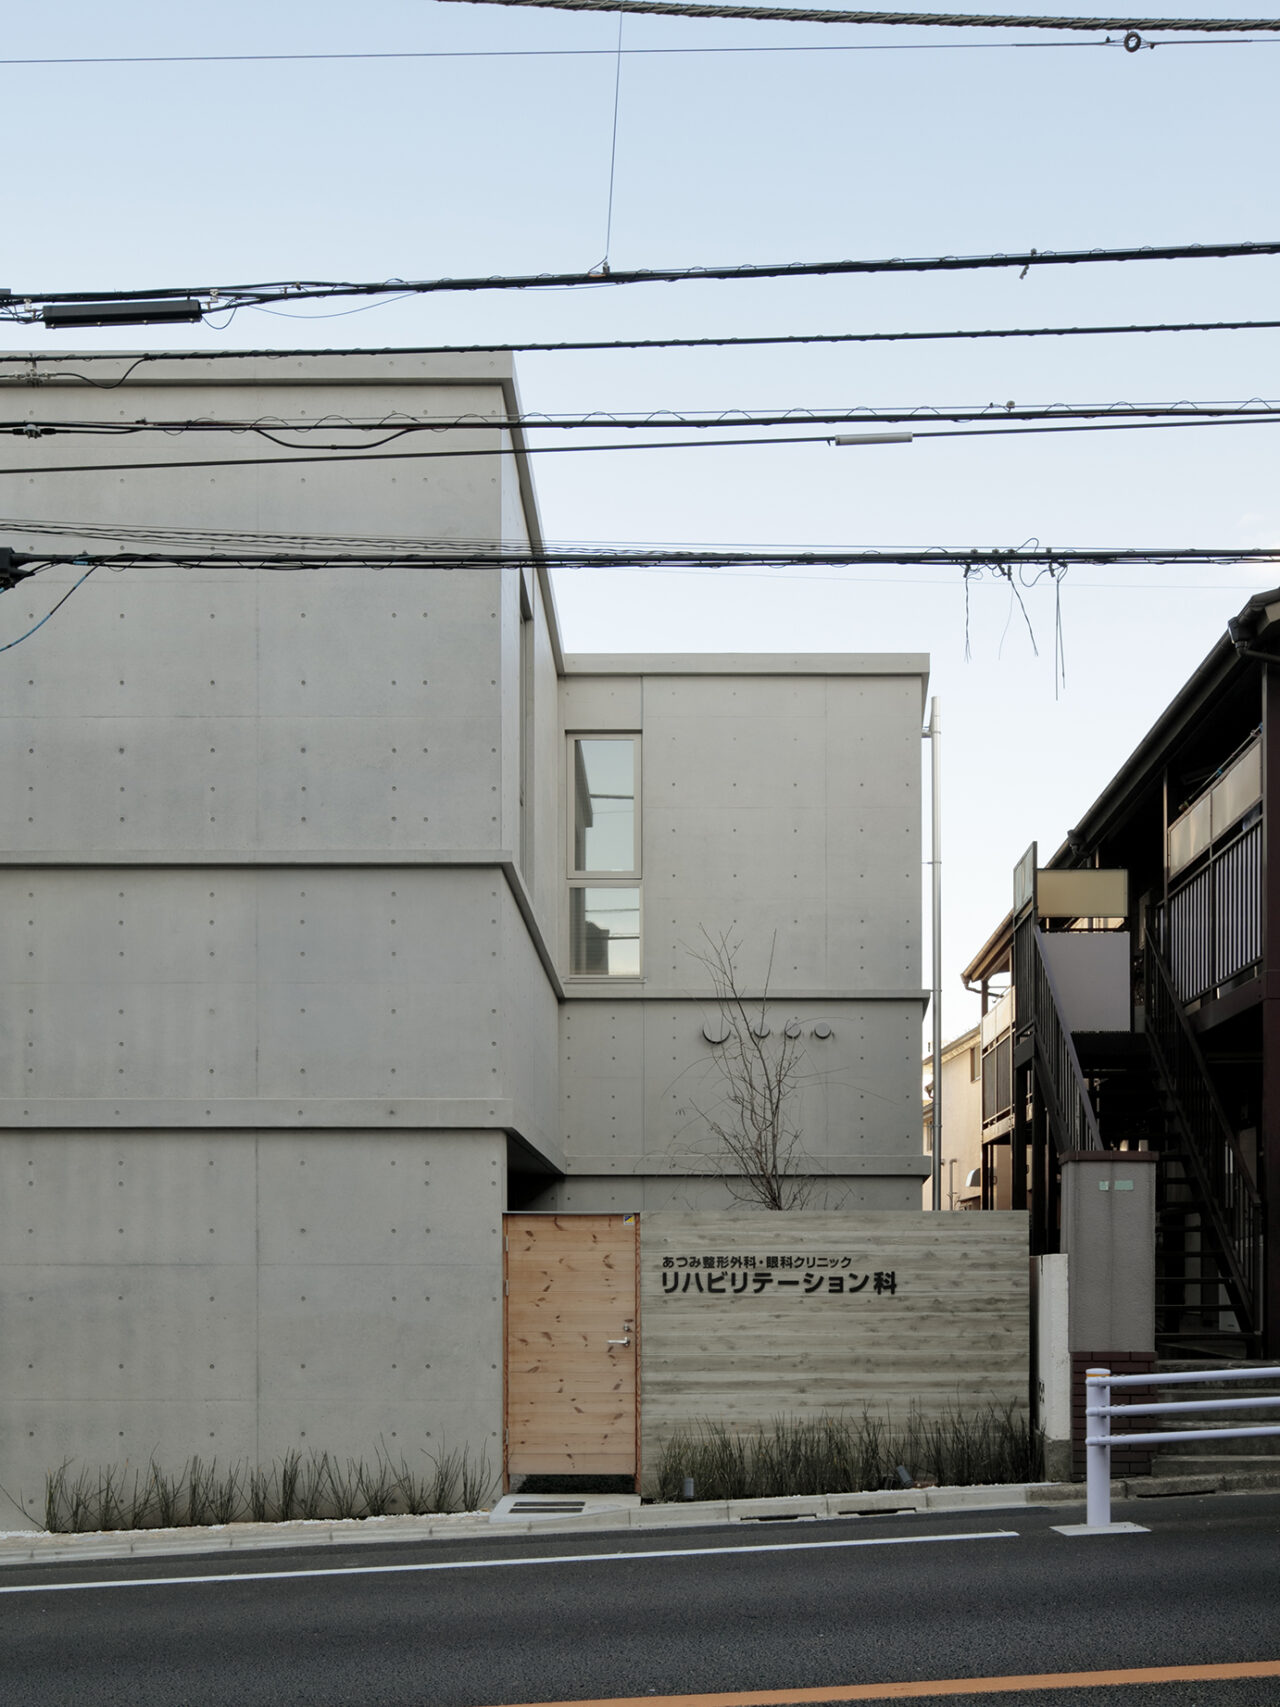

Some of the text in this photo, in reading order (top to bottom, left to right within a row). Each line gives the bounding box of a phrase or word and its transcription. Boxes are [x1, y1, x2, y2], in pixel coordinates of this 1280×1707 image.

[662, 1256, 852, 1269] あつみ整形外科・眼科クリニック
[662, 1271, 897, 1295] リハビリテーション科
